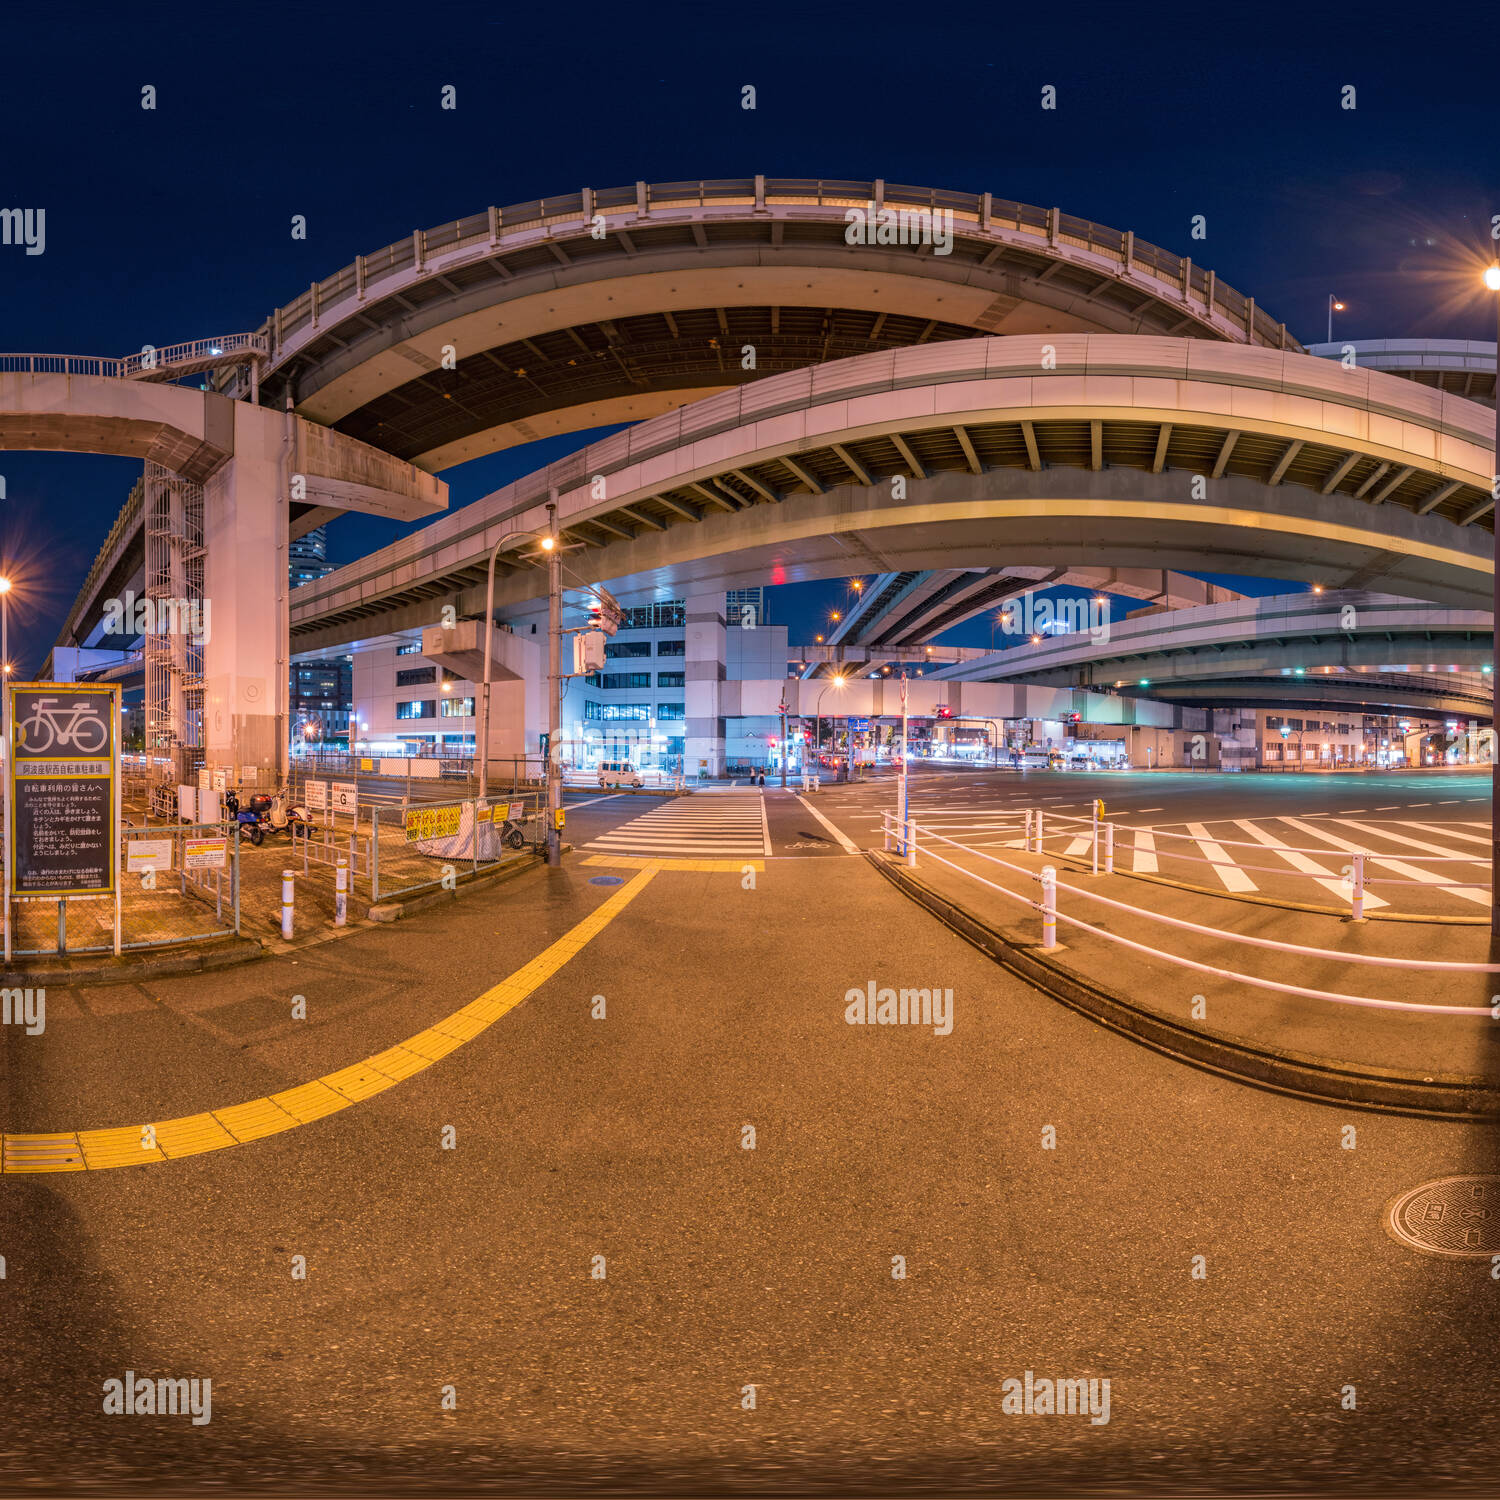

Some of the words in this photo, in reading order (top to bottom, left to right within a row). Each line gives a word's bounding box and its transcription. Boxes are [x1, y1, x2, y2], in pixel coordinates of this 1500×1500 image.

[23, 764, 103, 775] 阿波座駅西自転車駐車場
[24, 783, 103, 793] 自転車利用の皆さんへ
[340, 793, 347, 805] G
